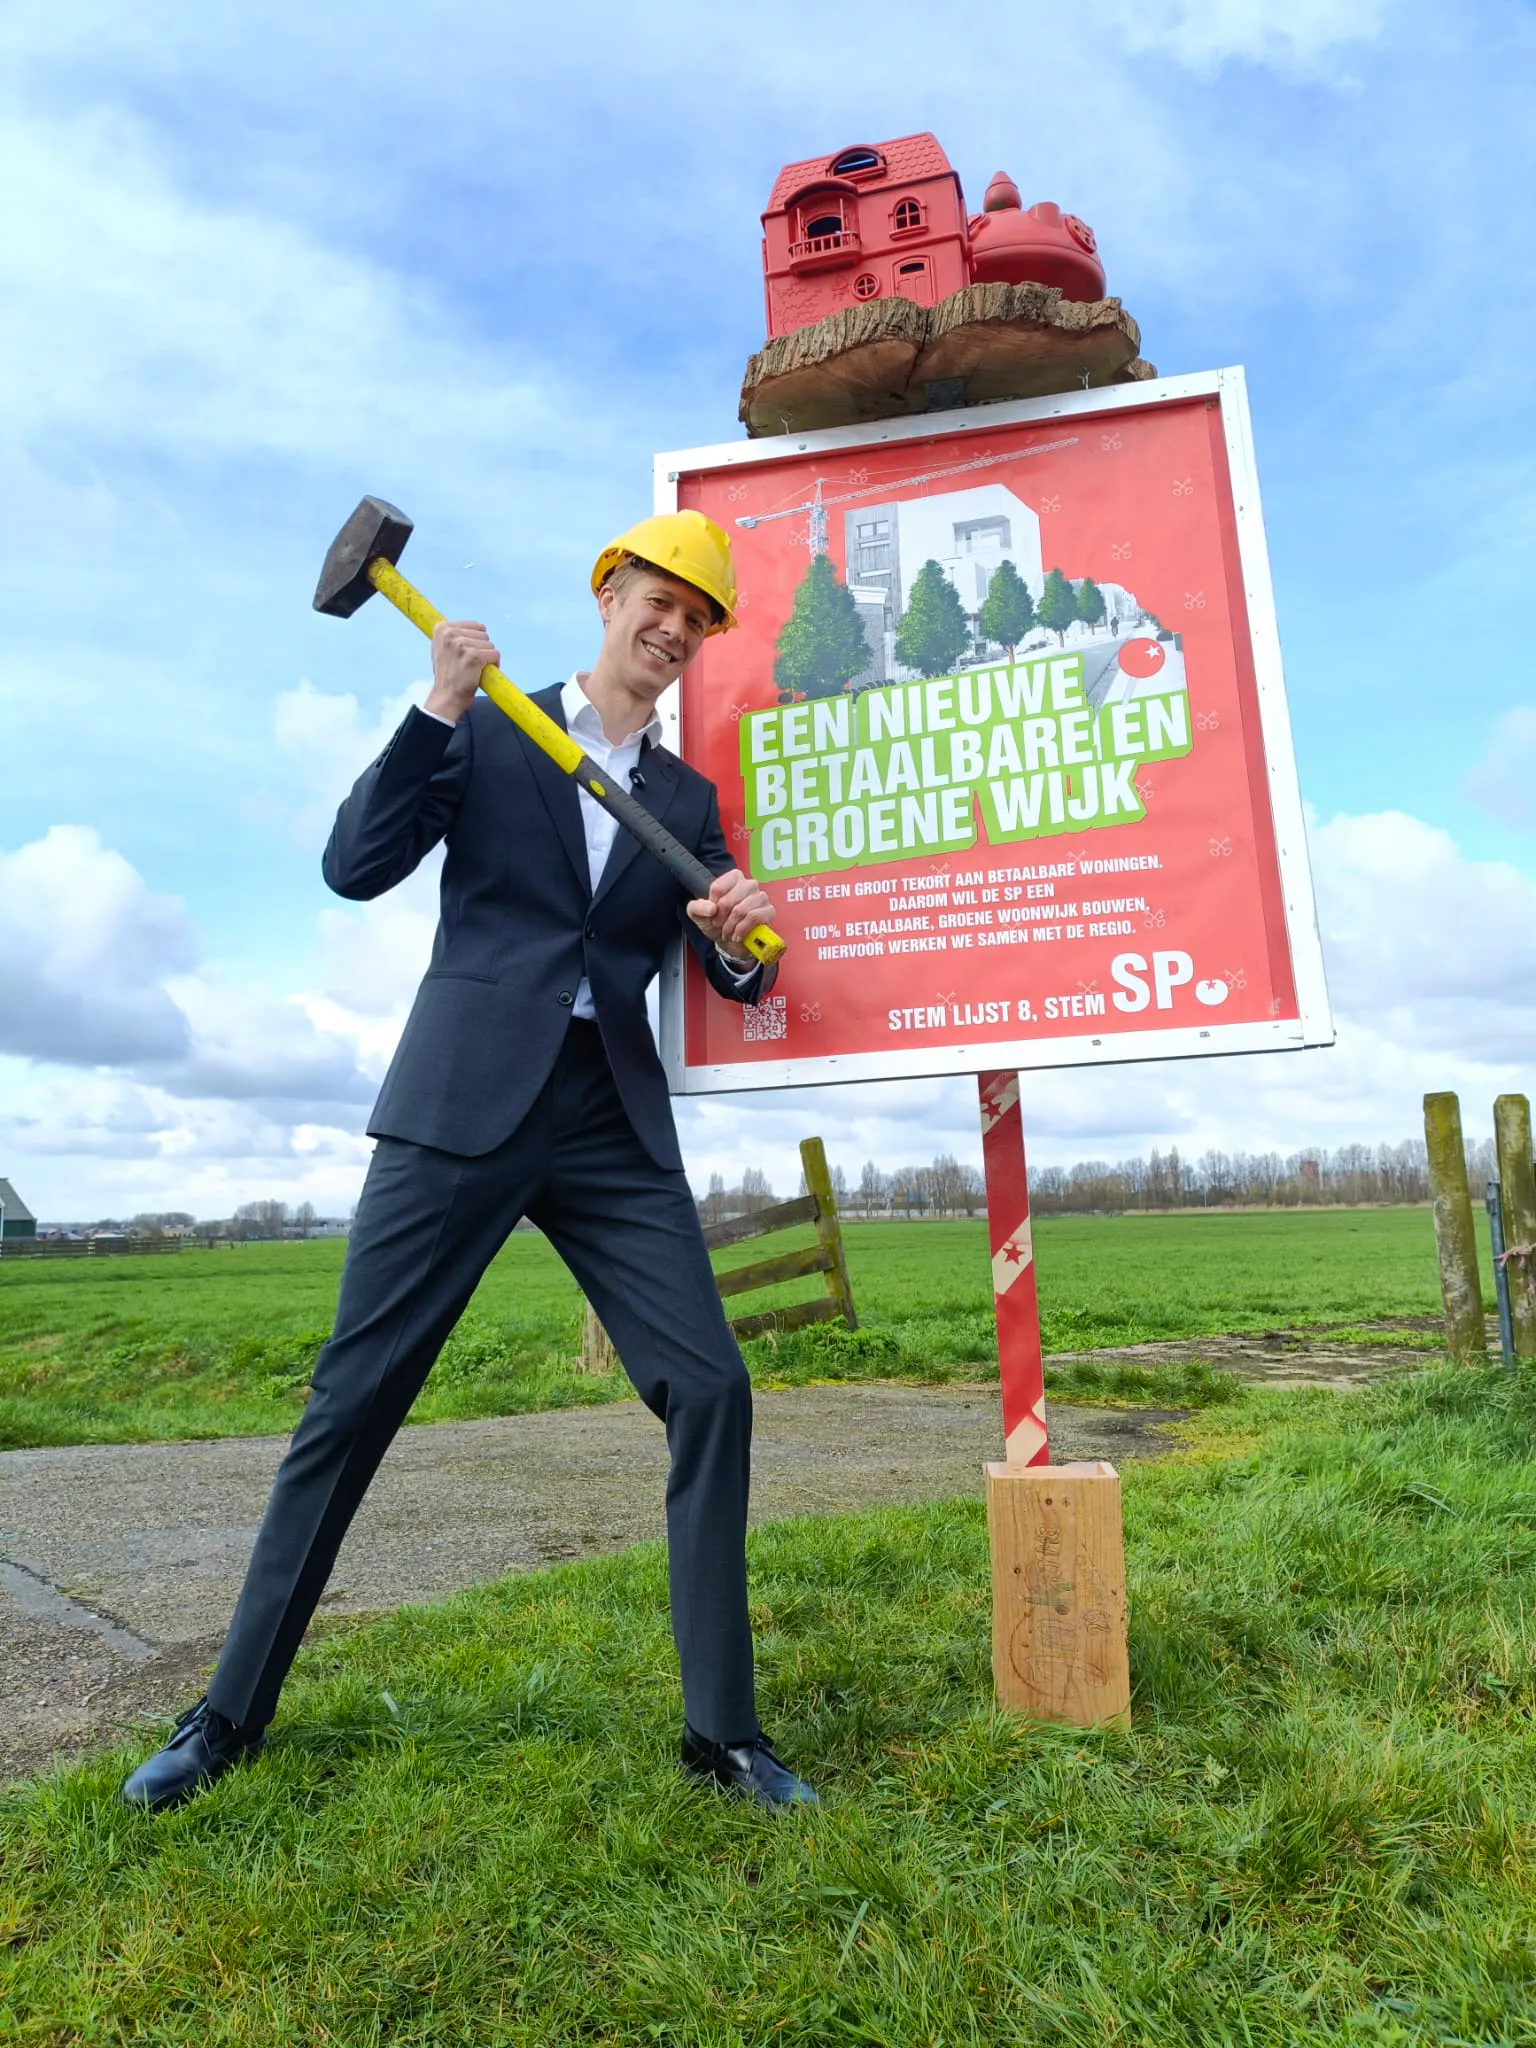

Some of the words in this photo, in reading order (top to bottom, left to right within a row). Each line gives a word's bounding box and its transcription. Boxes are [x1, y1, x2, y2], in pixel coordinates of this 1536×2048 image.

[750, 697, 851, 763] EEN
[867, 656, 1084, 743] NIEUWE
[755, 709, 1094, 817] BETAALBARE
[1110, 694, 1189, 757] EN
[760, 786, 973, 871] GROENE
[988, 758, 1141, 833] WIJK
[786, 887, 805, 903] ER
[807, 885, 821, 901] IS
[824, 883, 851, 900] EEN
[854, 879, 898, 897] GROOT
[900, 873, 952, 892] TEKORT
[954, 871, 985, 887] AAN
[987, 861, 1076, 884] BETAALBARE
[1079, 854, 1164, 876] WONINGEN.
[888, 892, 949, 912] DAAROM
[950, 890, 979, 906] WIL
[981, 887, 1001, 904] DE
[1003, 885, 1023, 902] SP
[1026, 882, 1055, 900] EEN
[803, 924, 841, 941] 100%
[845, 915, 935, 937] BETAALBARE,
[937, 910, 994, 929] GROENE
[996, 902, 1079, 926] WOONWIJK
[1081, 896, 1150, 917] BOUWEN.
[817, 941, 885, 961] HIERVOOR
[887, 935, 947, 955] WERKEN
[950, 933, 974, 949] WE
[976, 928, 1029, 947] SAMEN
[1031, 925, 1063, 943] MET
[1065, 923, 1085, 940] DE
[1088, 919, 1137, 937] REGIO.
[887, 1004, 947, 1031] STEM
[952, 1000, 1011, 1027] LIJST
[1017, 999, 1038, 1023] 8,
[1044, 992, 1106, 1020] STEM
